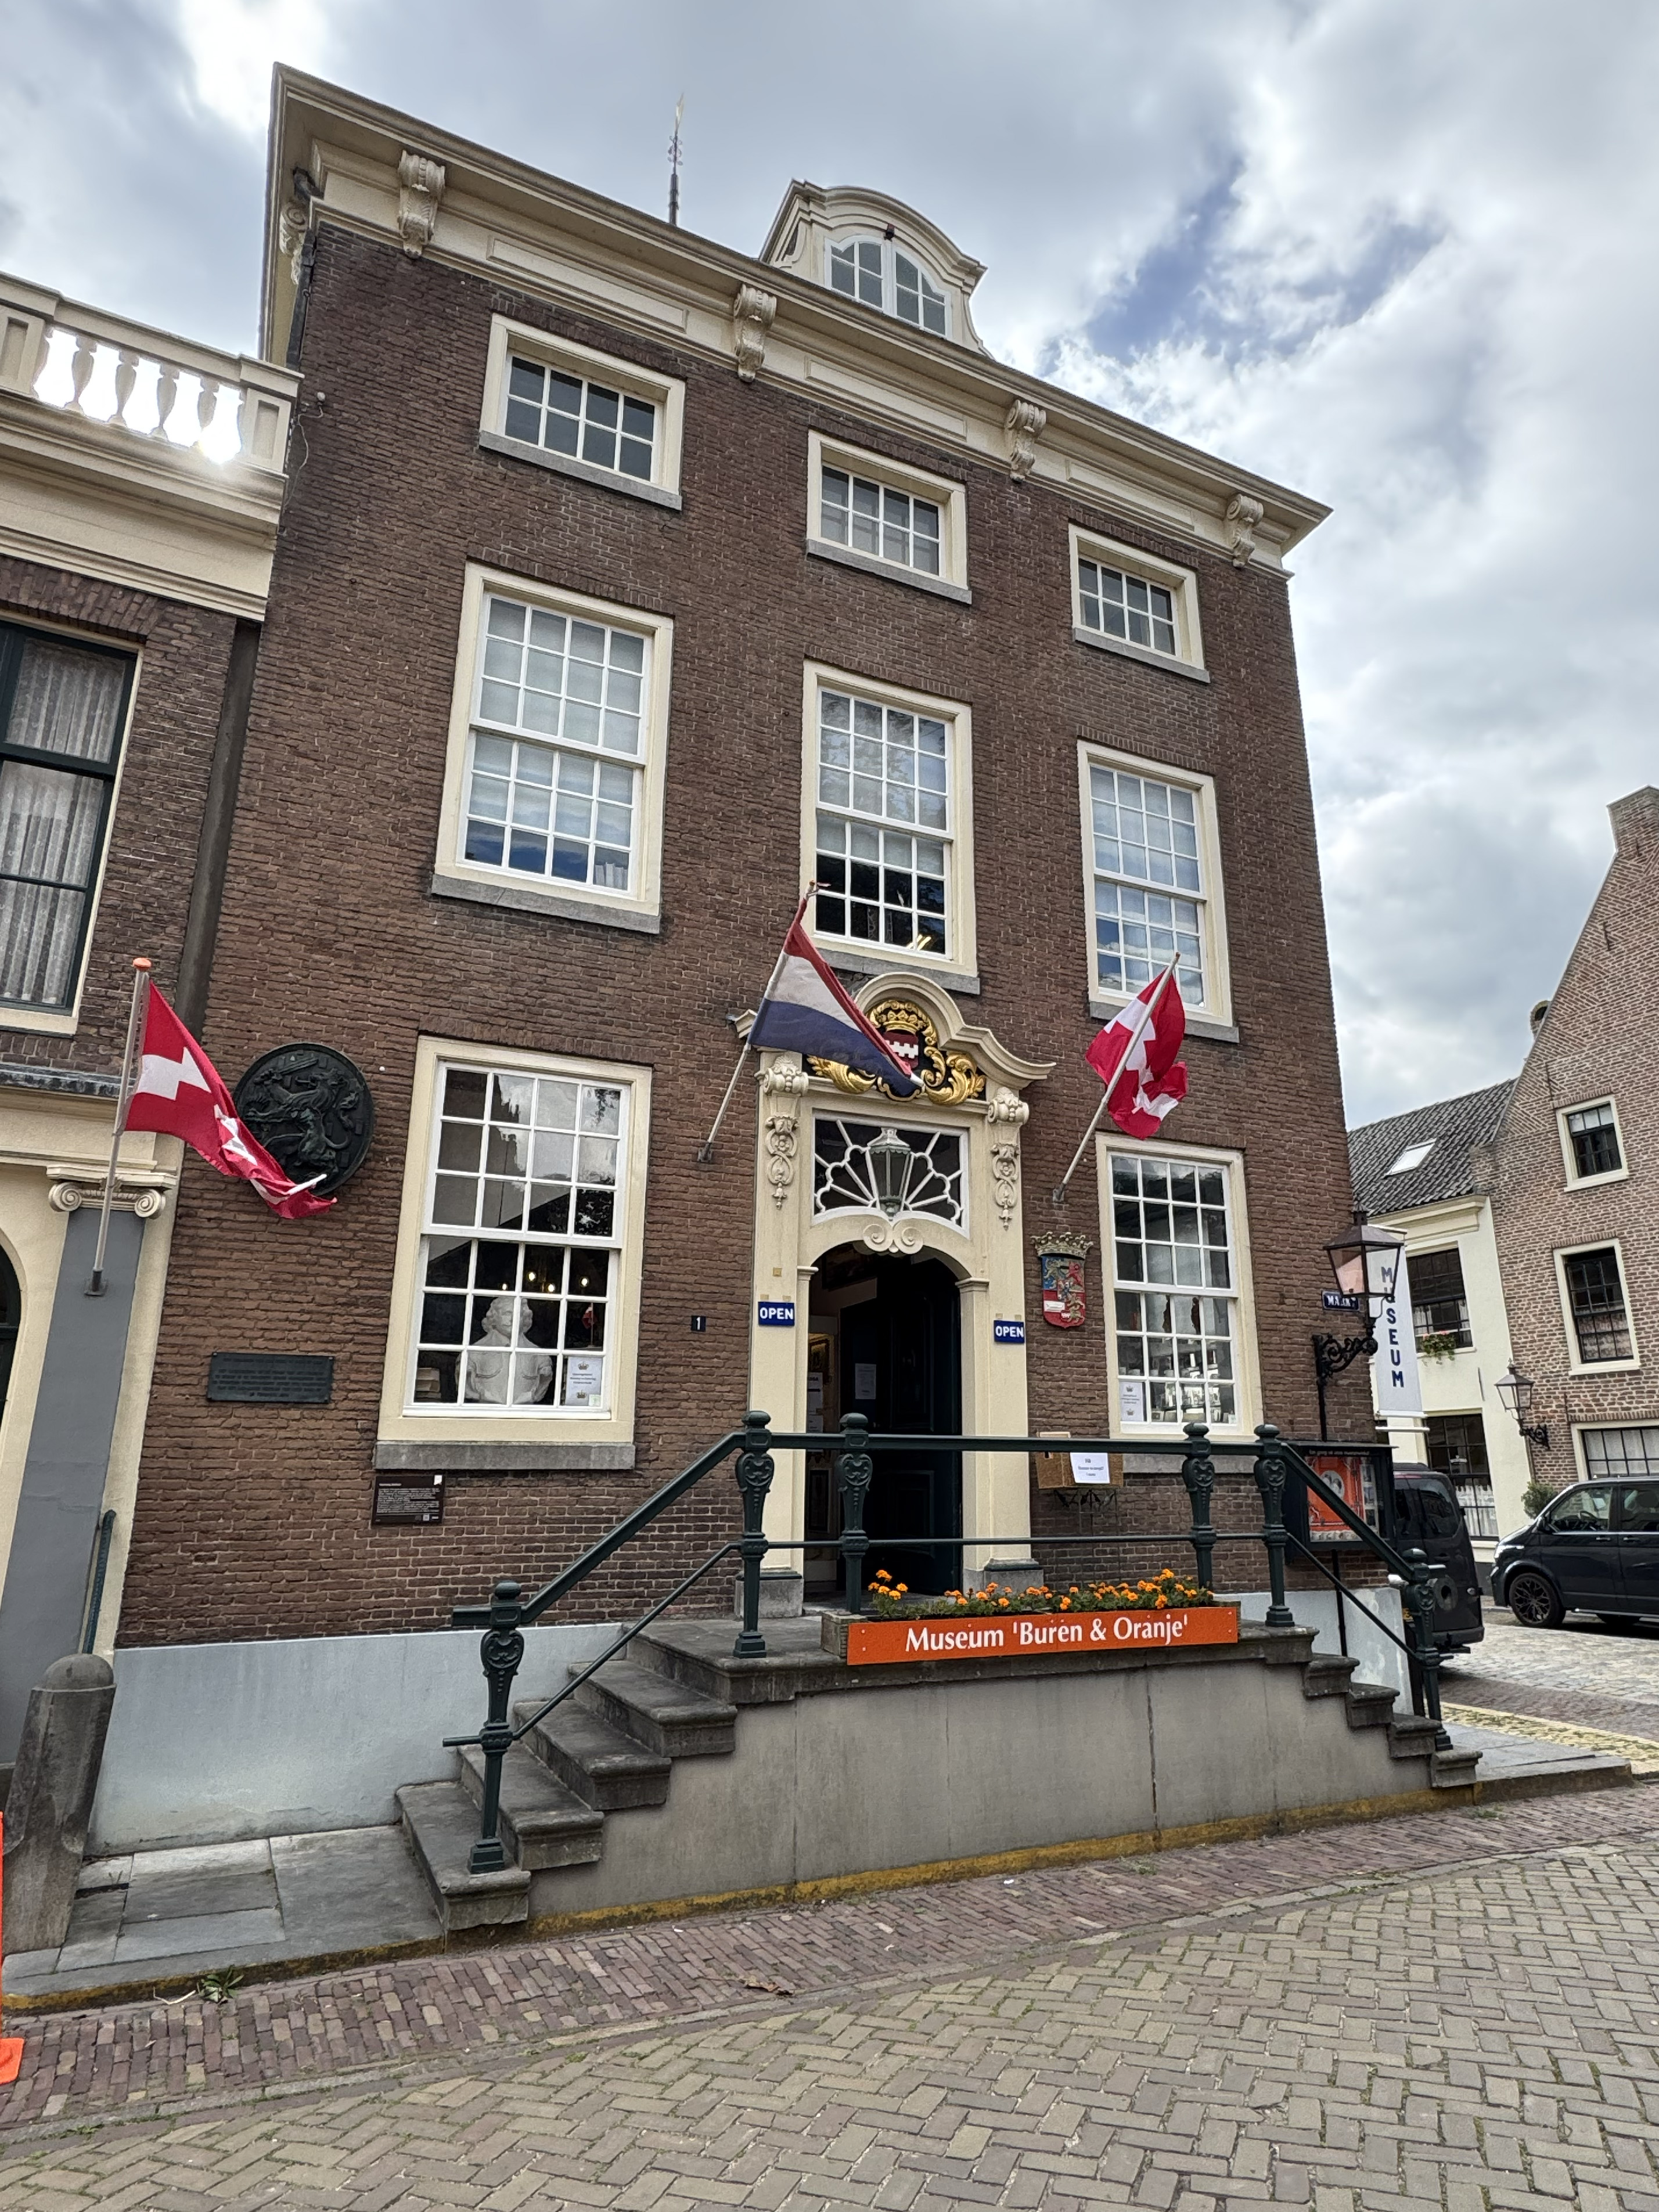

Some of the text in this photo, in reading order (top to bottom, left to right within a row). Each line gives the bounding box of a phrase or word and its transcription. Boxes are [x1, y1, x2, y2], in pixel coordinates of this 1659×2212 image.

[760, 1307, 794, 1320] OPEN
[696, 1316, 700, 1330] 1
[995, 1325, 1024, 1338] OPEN
[905, 1613, 1188, 1652] Museum 'Buren & Oranje'
